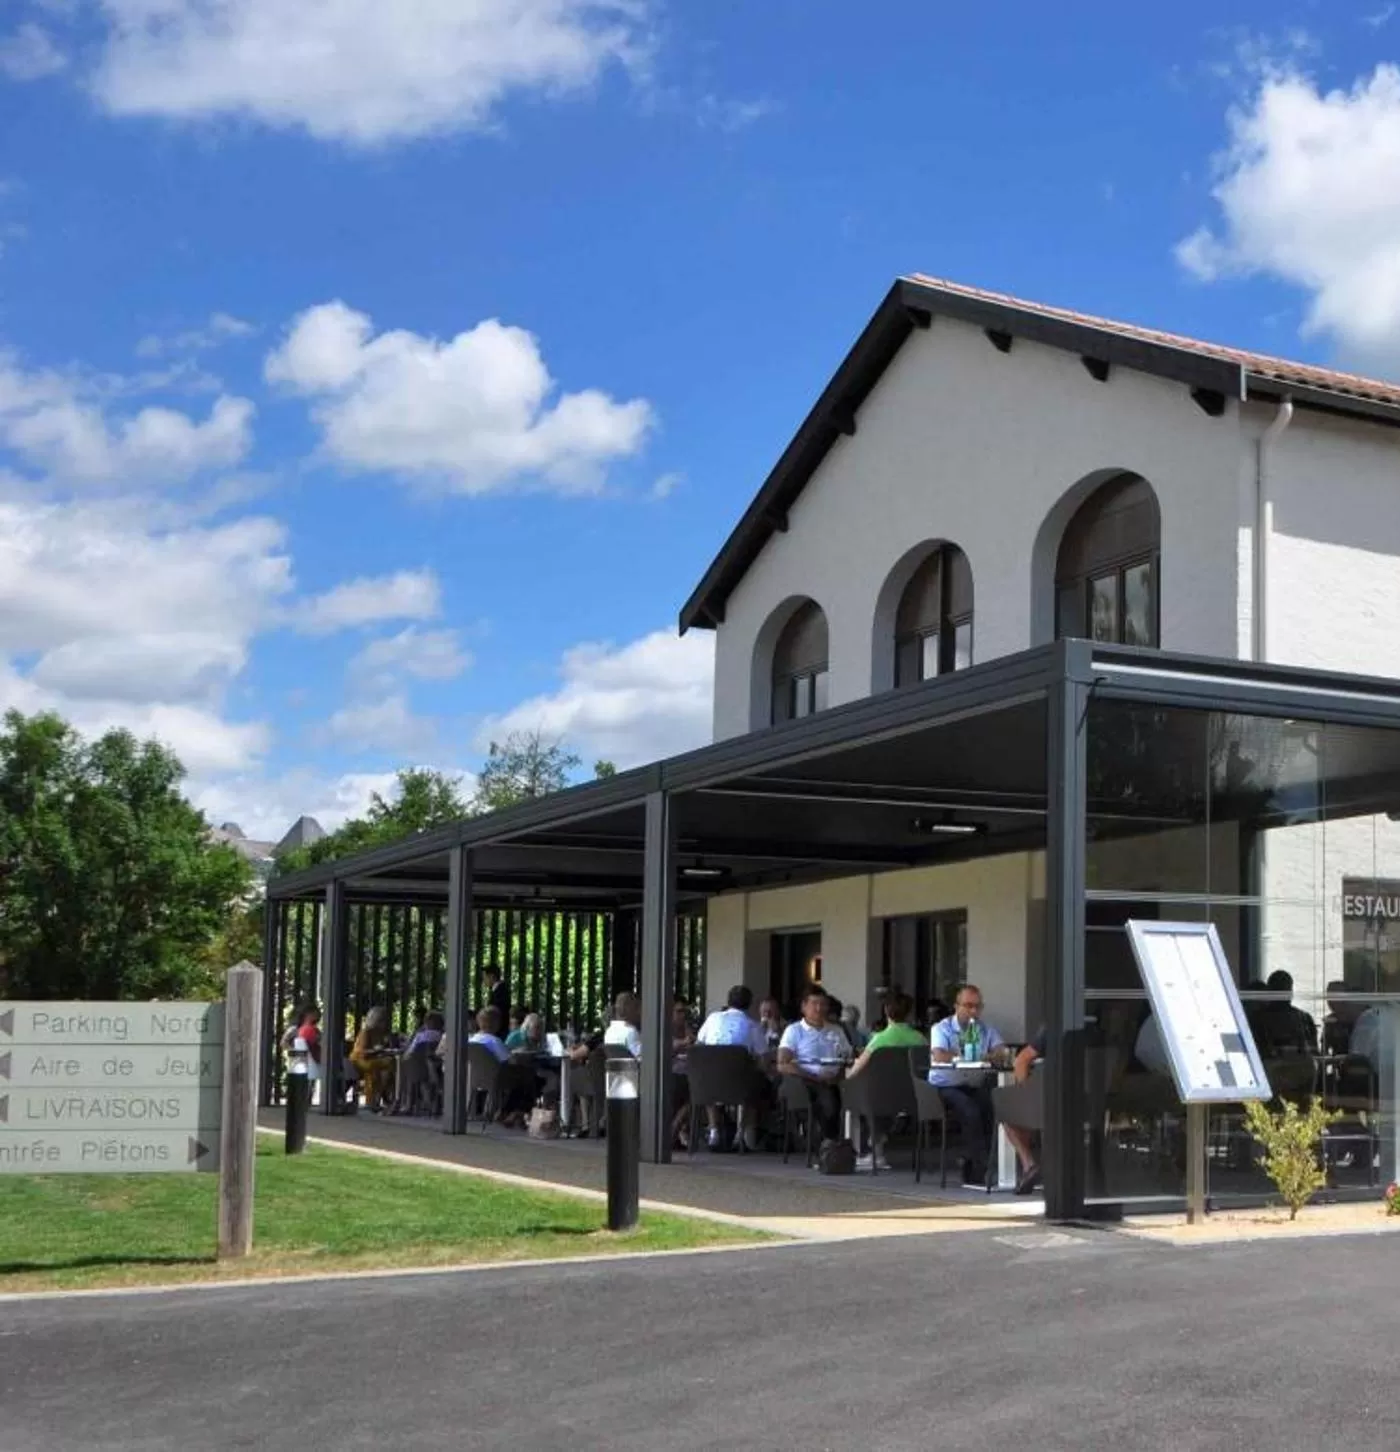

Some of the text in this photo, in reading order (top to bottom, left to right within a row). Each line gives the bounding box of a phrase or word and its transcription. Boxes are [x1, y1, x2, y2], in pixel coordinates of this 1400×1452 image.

[31, 1012, 210, 1040] Parking Nord
[31, 1054, 213, 1077] Aire de Jeux
[26, 1098, 181, 1120] LIVRAISONS
[0, 1139, 170, 1163] ntrée Piétons
